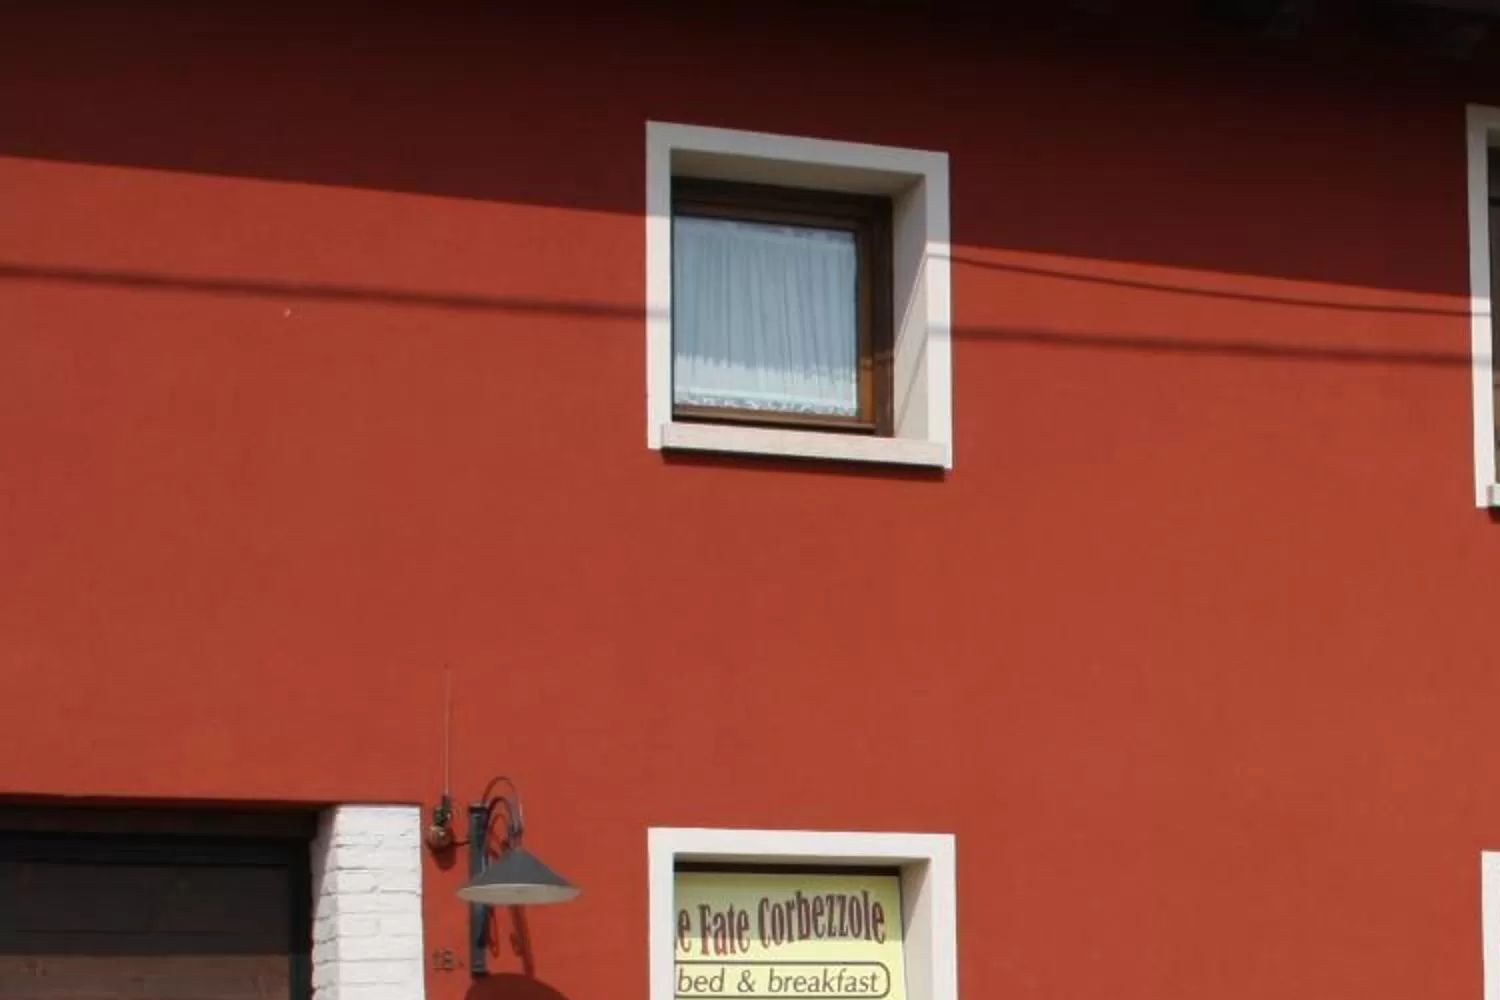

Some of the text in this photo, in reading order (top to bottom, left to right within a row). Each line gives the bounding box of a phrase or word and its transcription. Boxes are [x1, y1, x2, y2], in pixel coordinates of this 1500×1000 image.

[697, 903, 750, 957] Fate
[757, 889, 886, 949] Corbezzole
[677, 967, 879, 993] bed & breakfast
